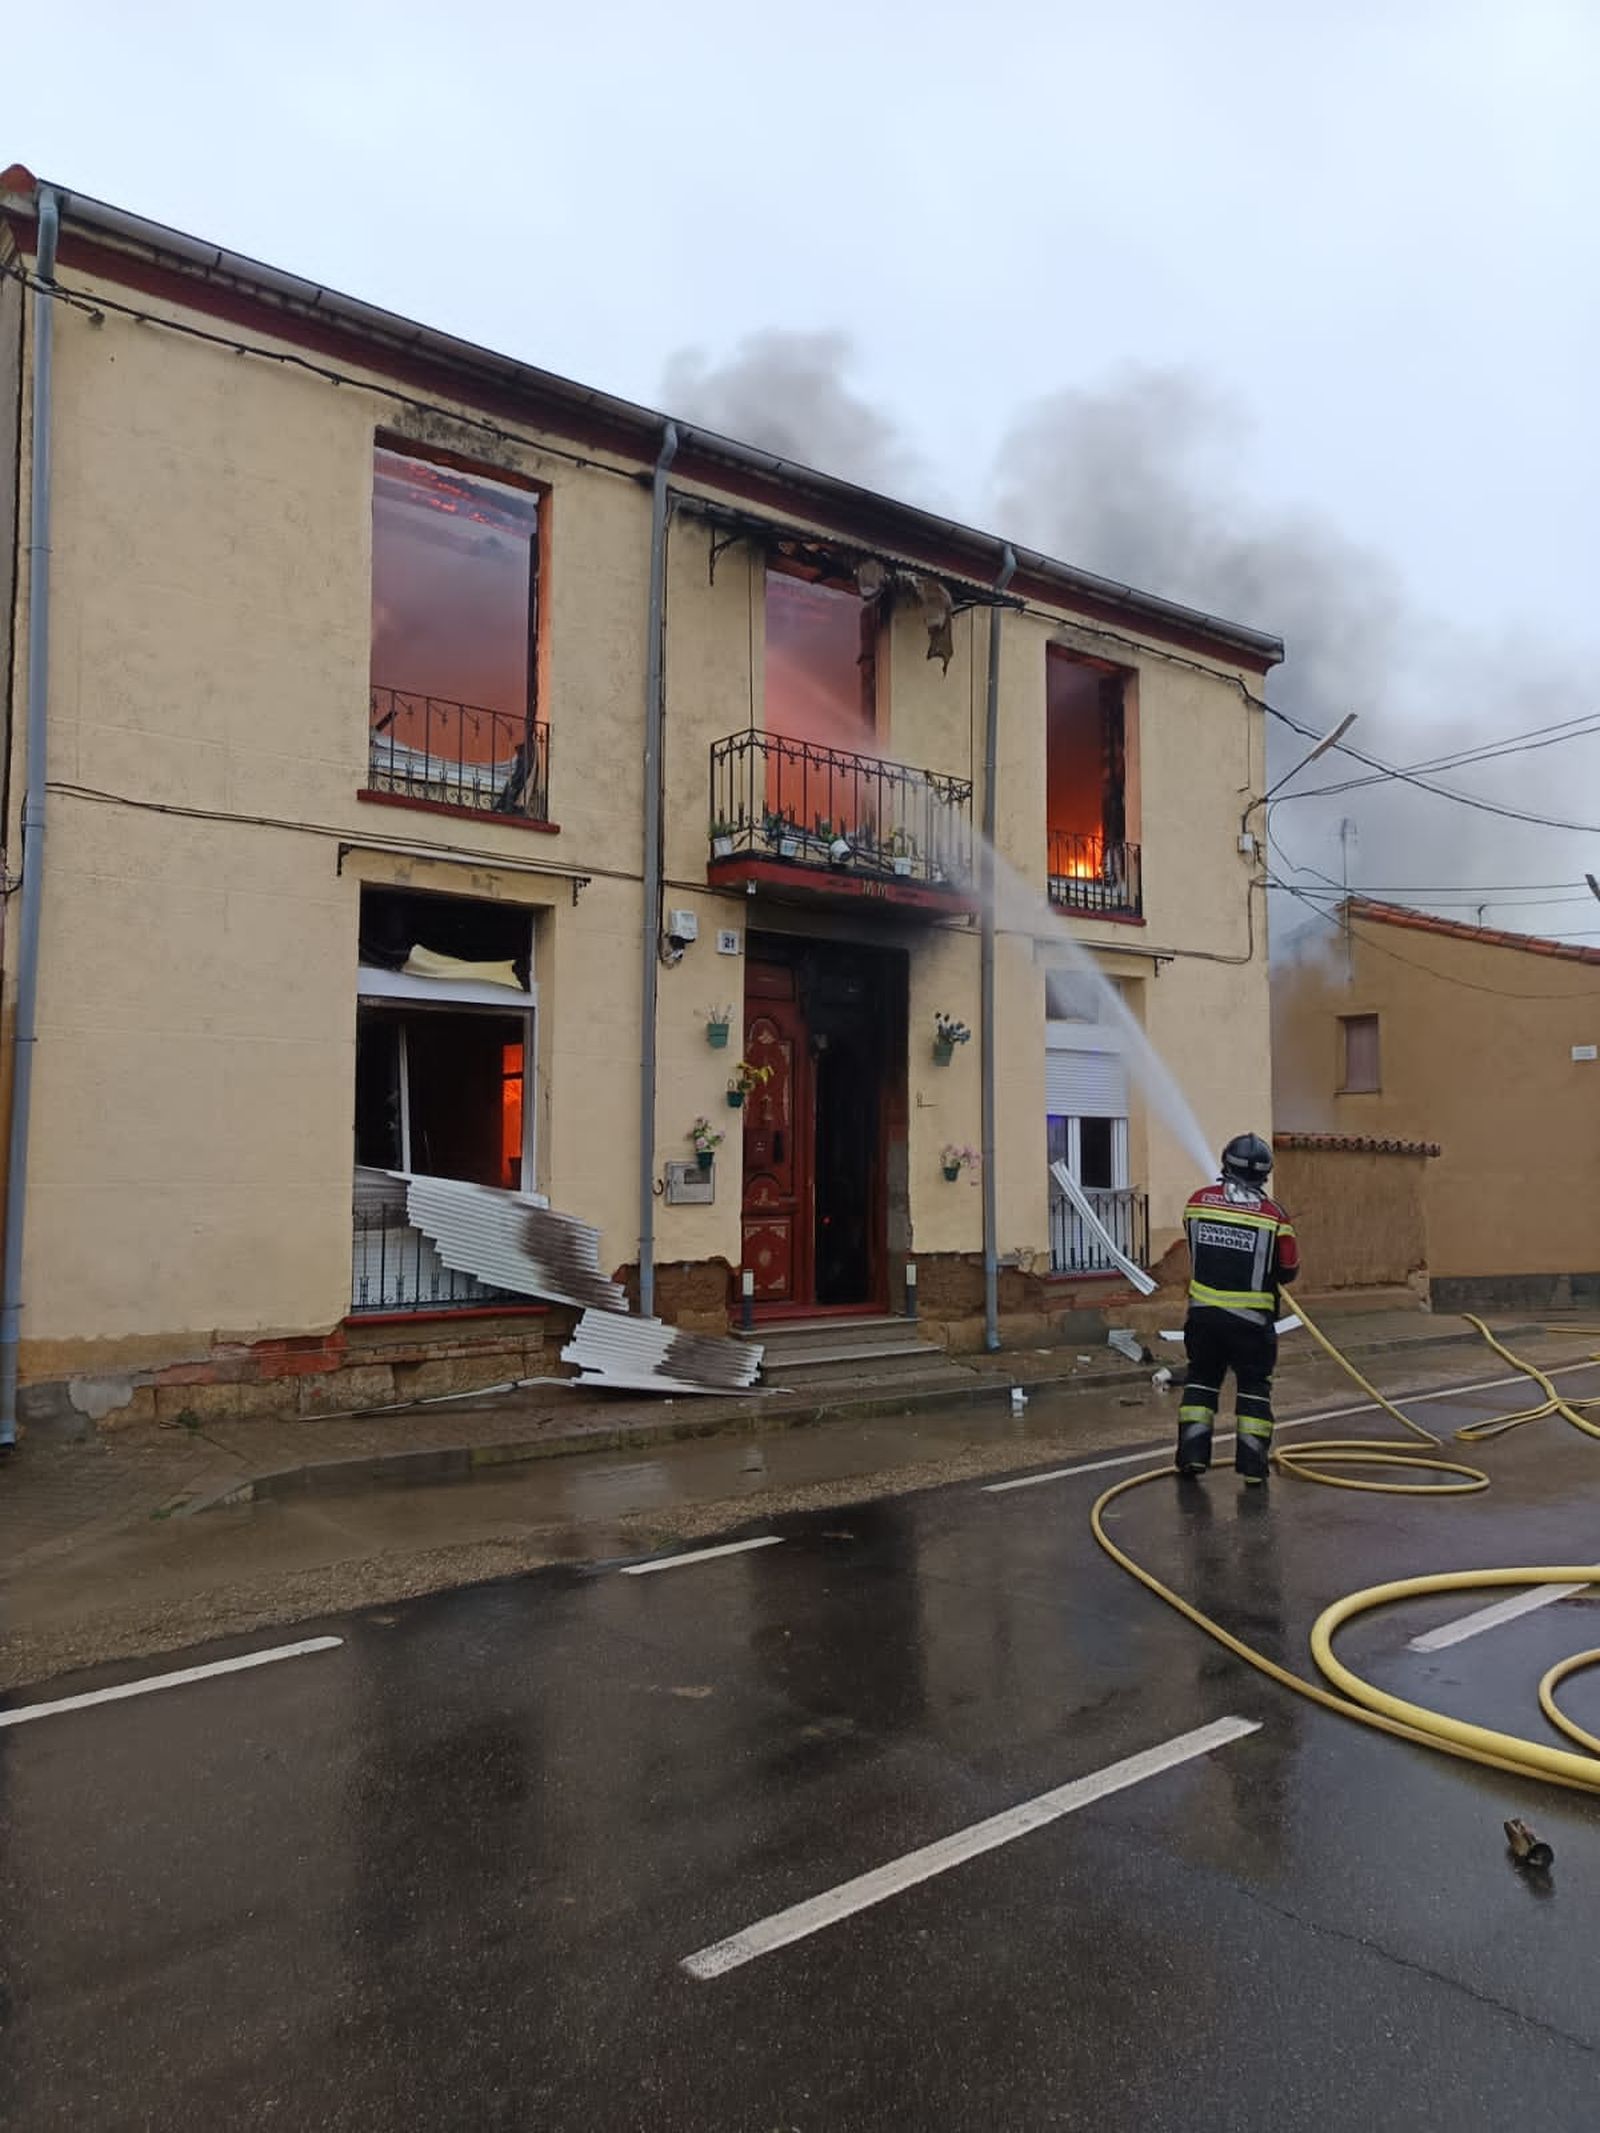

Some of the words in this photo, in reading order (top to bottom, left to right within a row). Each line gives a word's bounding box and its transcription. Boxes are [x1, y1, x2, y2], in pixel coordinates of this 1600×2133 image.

[724, 936, 735, 949] 21
[1200, 1224, 1254, 1241] CONSORCIO
[1200, 1233, 1252, 1249] ZAMORA
